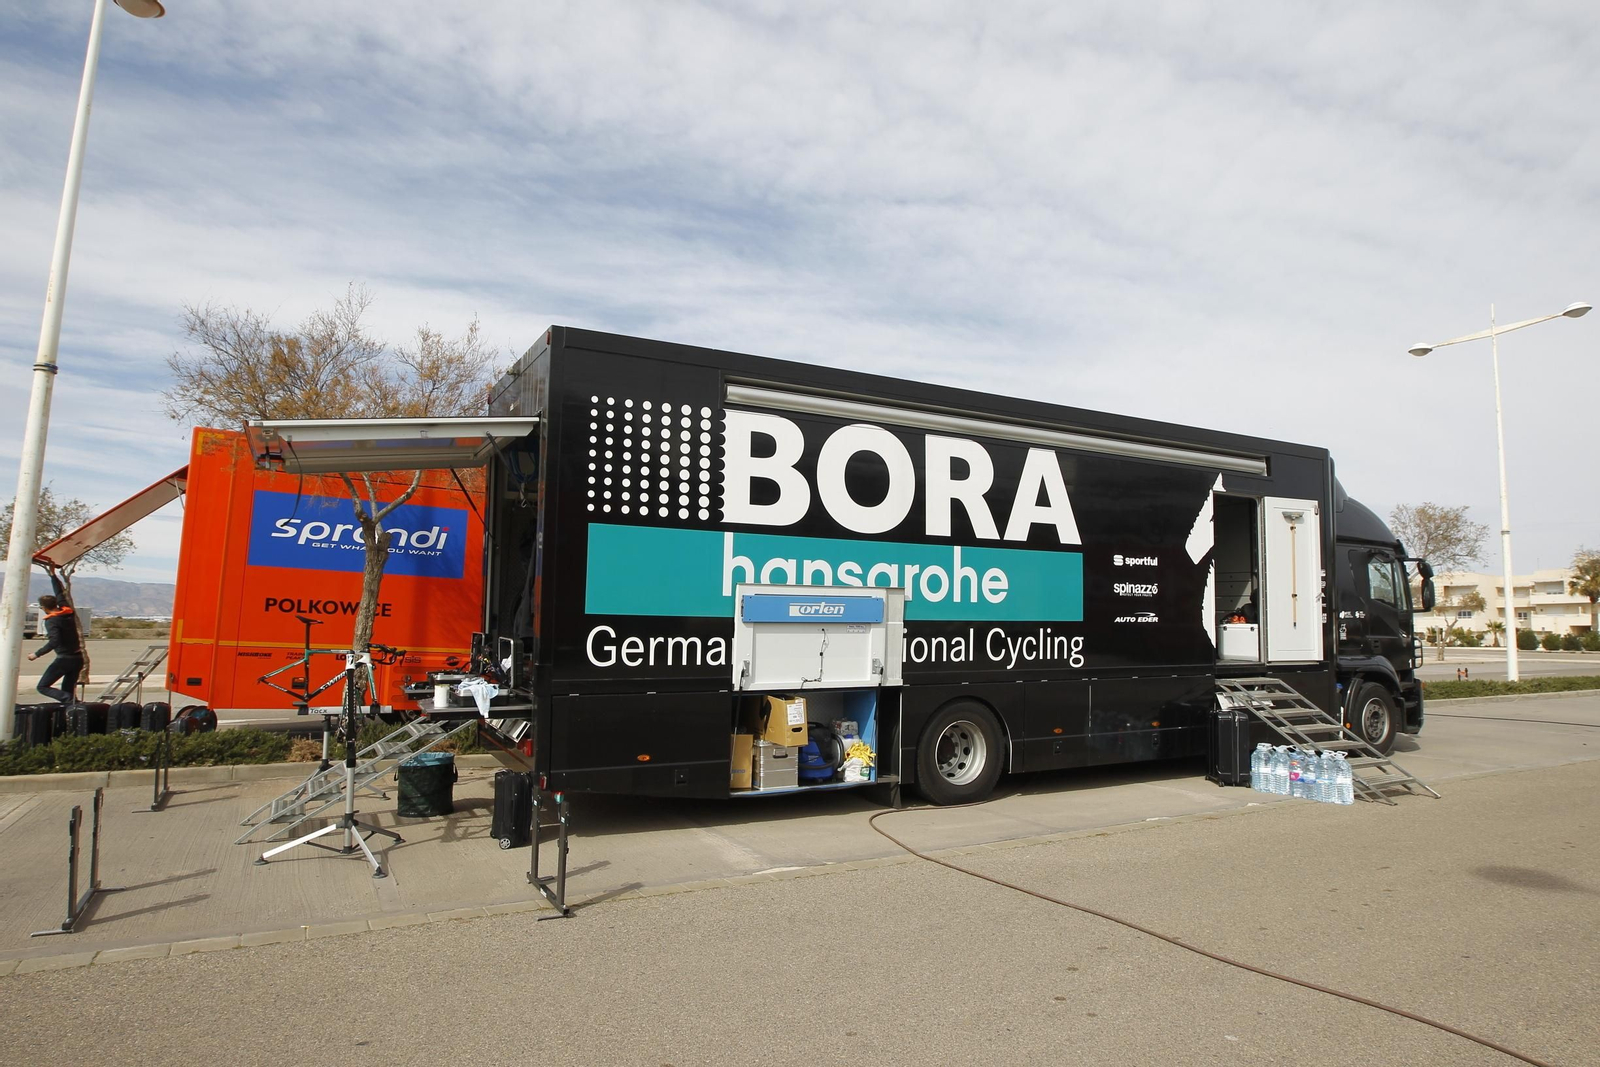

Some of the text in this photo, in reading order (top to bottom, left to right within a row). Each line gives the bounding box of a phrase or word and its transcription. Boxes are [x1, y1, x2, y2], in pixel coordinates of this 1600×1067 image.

[719, 408, 1082, 545] BORA
[1125, 556, 1158, 567] sportful
[264, 597, 392, 617] POLKOWE
[586, 625, 735, 667] Germa
[986, 628, 1085, 669] Cycling
